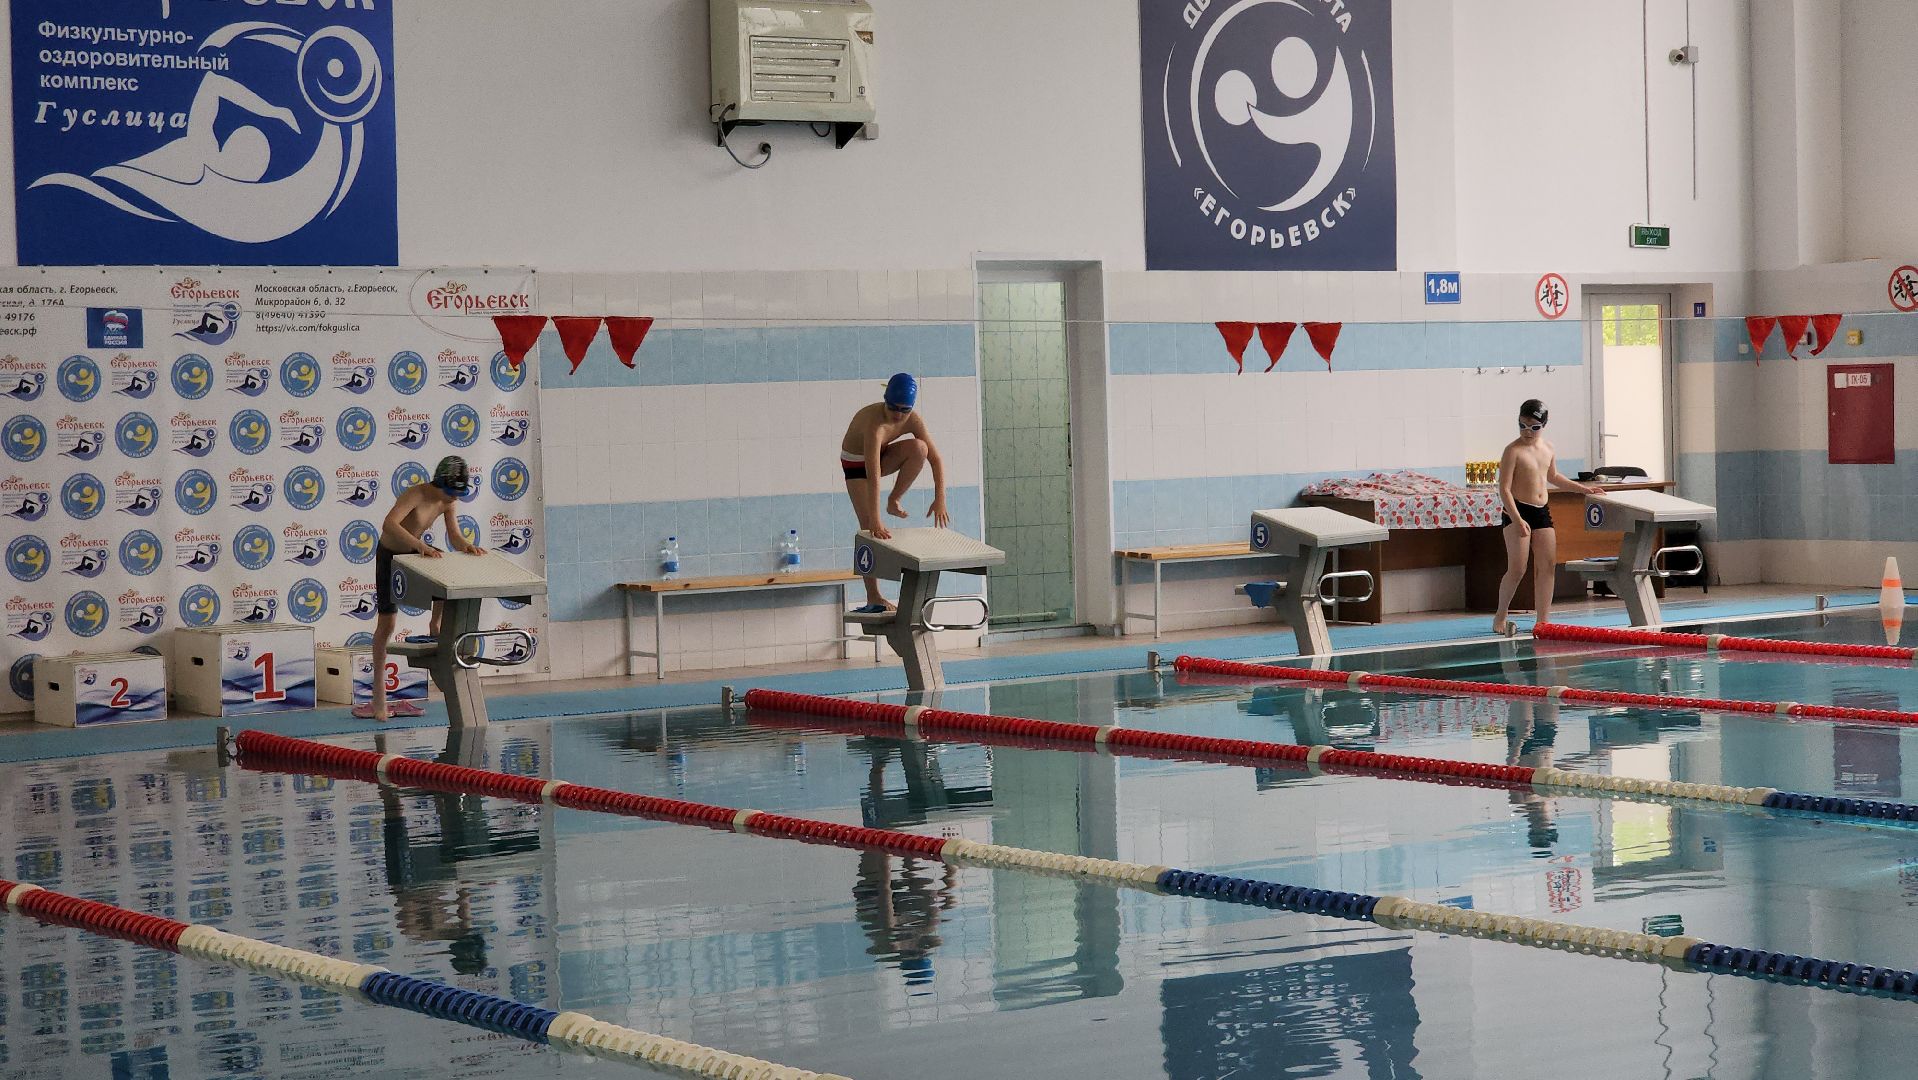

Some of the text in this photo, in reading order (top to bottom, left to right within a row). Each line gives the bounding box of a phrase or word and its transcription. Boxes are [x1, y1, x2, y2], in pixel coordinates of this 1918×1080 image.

[38, 21, 194, 46] Физкультурно-
[39, 49, 230, 71] оздоровительный
[40, 74, 139, 92] комплекс
[34, 101, 188, 133] Гуслица
[254, 284, 306, 293] Московская
[309, 284, 345, 294] область,
[255, 297, 311, 307] Микрорайон
[335, 297, 346, 306] 32
[427, 289, 529, 315] Егорьевск
[5, 312, 35, 321] 49176
[1591, 507, 1599, 523] 6
[1257, 527, 1264, 543] 5
[861, 550, 869, 568] 4
[395, 574, 403, 595] 3
[254, 652, 285, 700] 1
[384, 662, 400, 691] 3
[110, 677, 130, 707] 2
